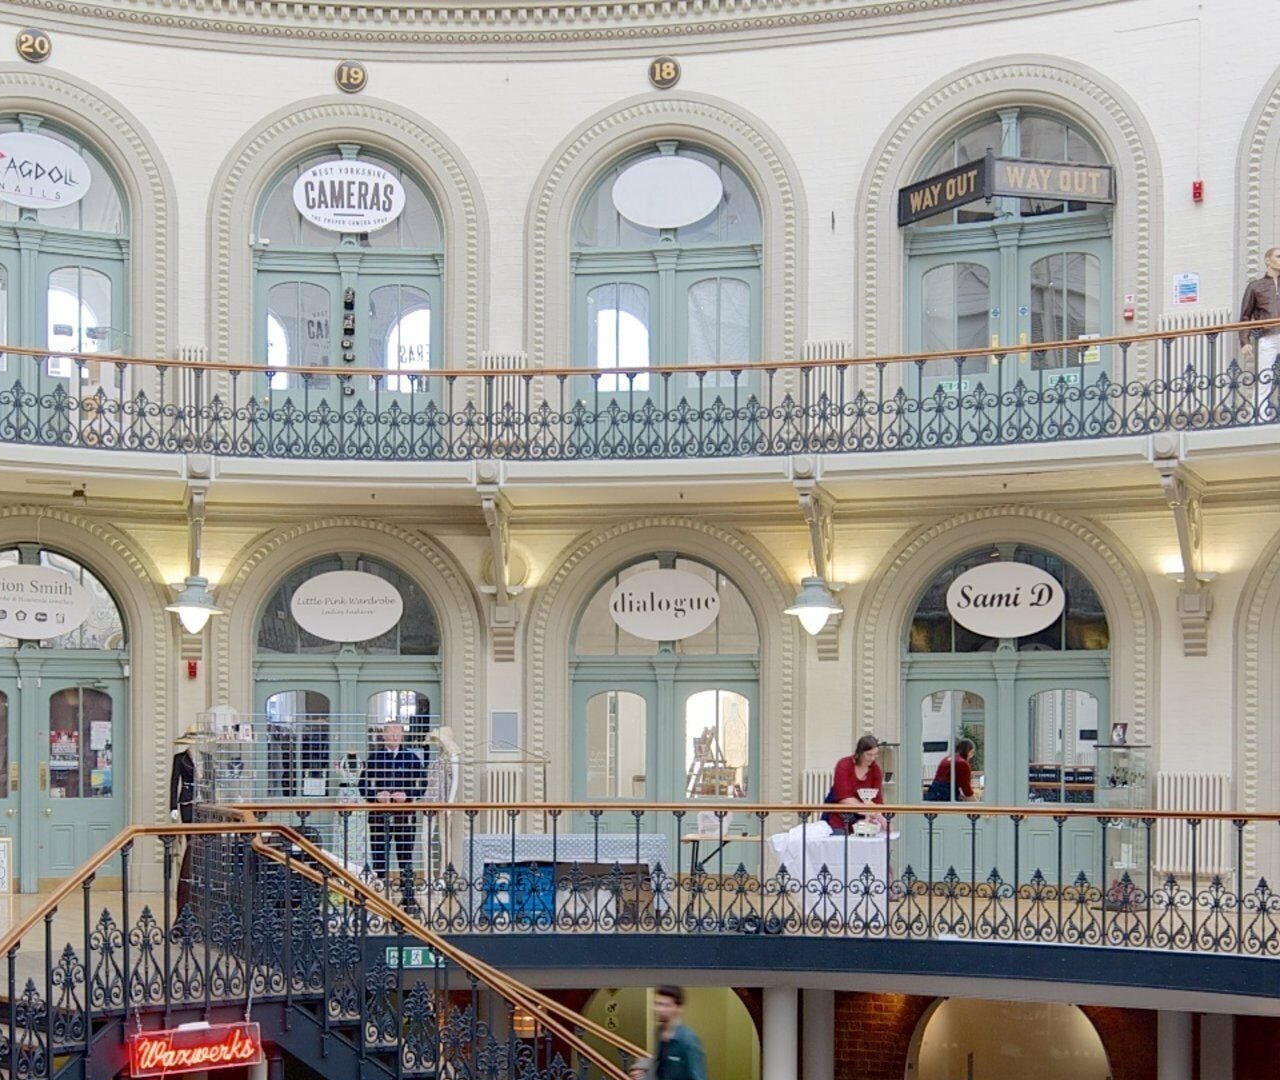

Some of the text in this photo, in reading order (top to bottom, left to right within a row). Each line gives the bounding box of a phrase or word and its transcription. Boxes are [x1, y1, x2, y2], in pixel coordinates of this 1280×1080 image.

[20, 34, 49, 54] 20
[341, 66, 363, 84] 19
[654, 62, 676, 81] 18
[312, 166, 387, 180] WEST YORKSHIRE
[1006, 166, 1100, 194] WAY OUT
[304, 179, 394, 213] CAMERAS
[910, 170, 978, 214] WAY OUT
[29, 580, 73, 596] Smith
[957, 583, 1053, 609] Sami D
[297, 596, 396, 606] Little Pink Wardrobe
[614, 592, 716, 618] dialogue
[139, 1029, 254, 1069] Waxwerks
